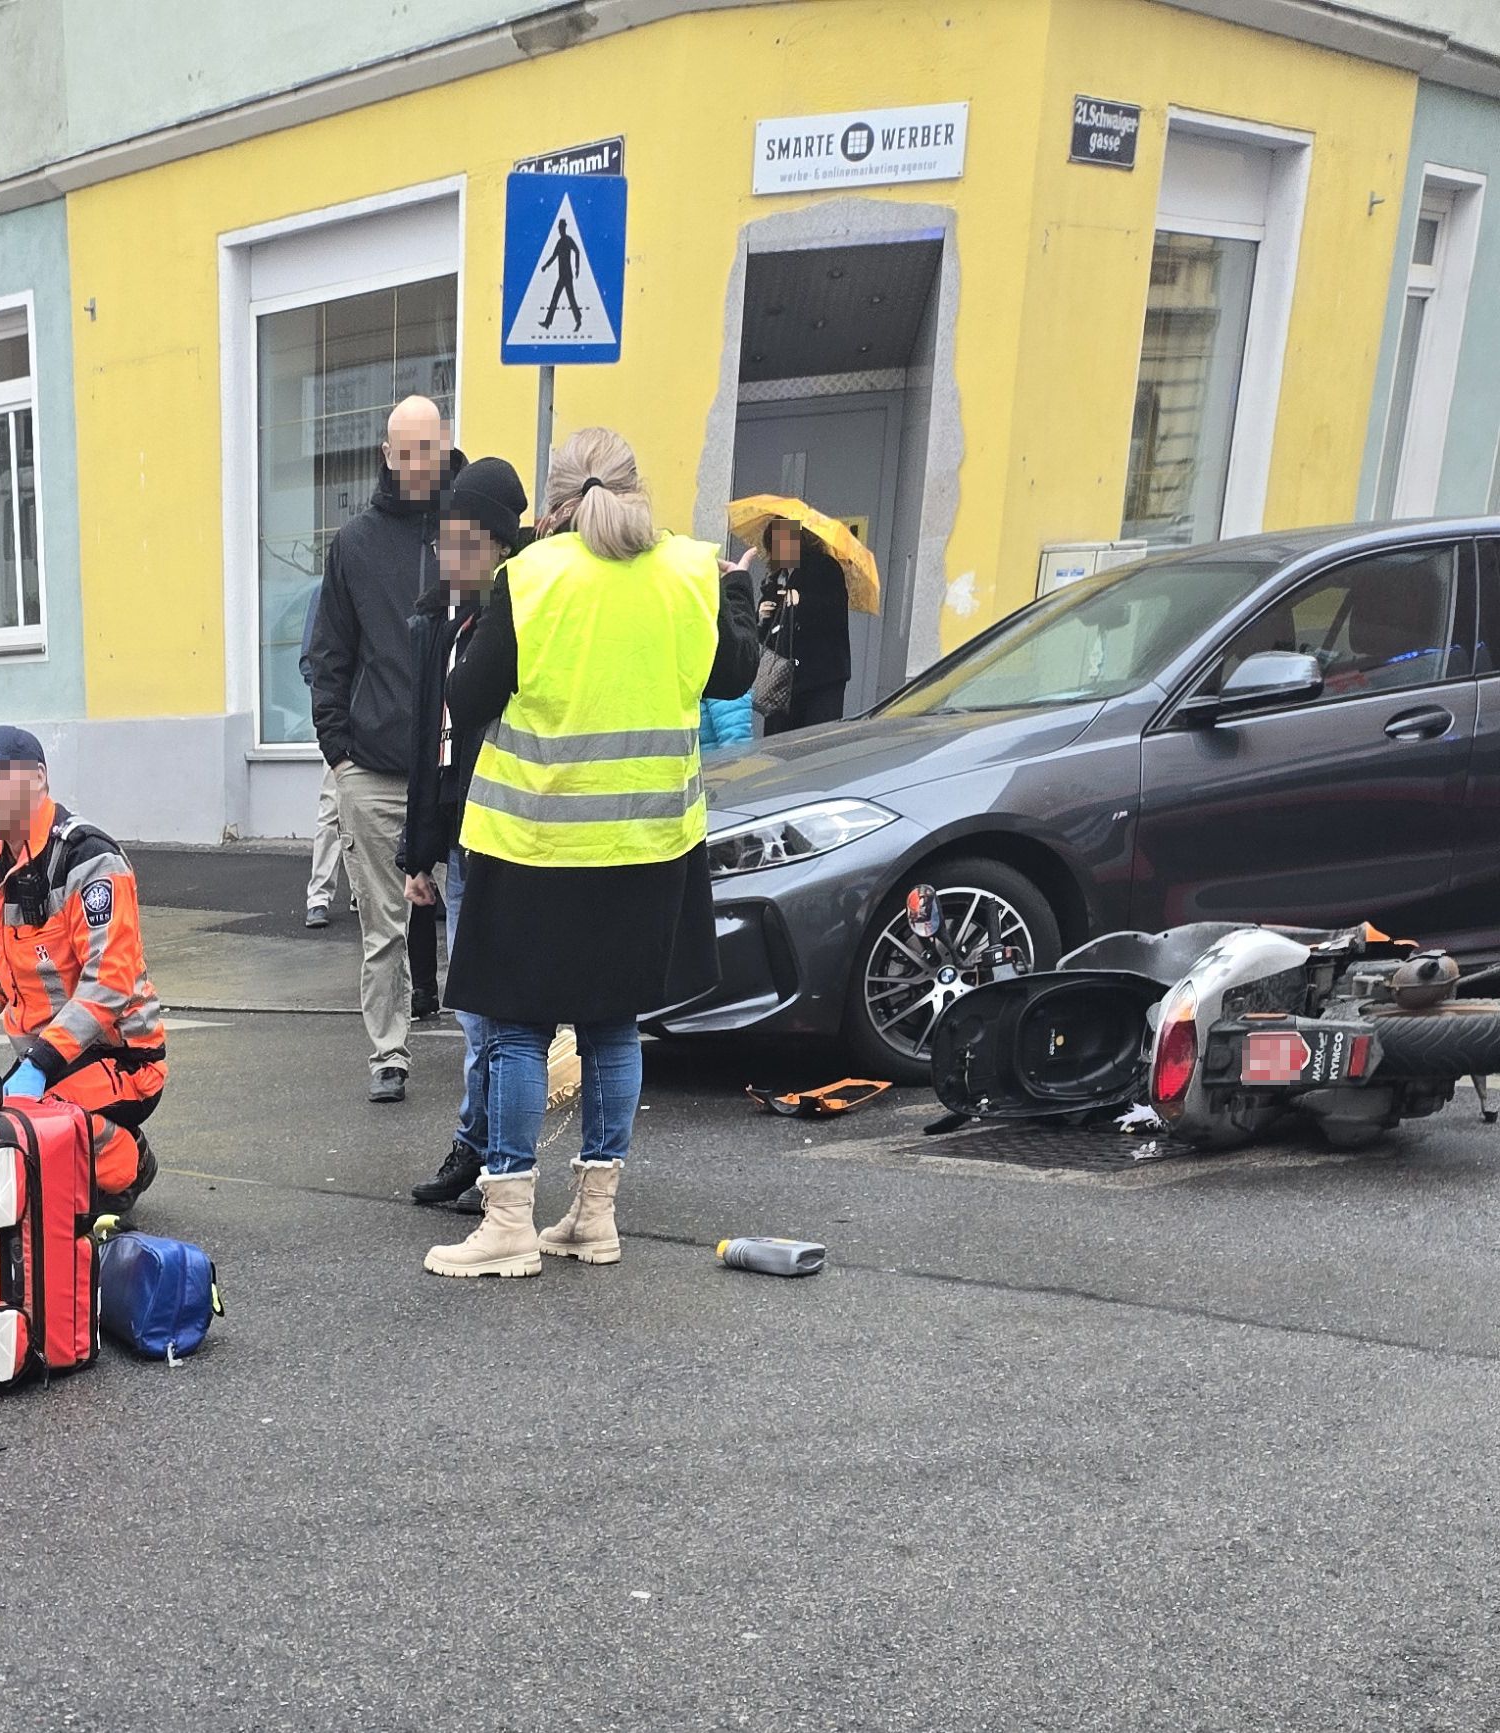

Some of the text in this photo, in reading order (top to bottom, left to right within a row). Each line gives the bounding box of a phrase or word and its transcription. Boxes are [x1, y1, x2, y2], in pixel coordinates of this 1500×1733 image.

[766, 123, 955, 161] SMARTE WERBER
[1089, 132, 1121, 153] gasse
[821, 161, 899, 179] onlinemarketing
[901, 160, 938, 175] agentur
[1312, 1049, 1325, 1082] MAXX
[1329, 1031, 1344, 1080] KYMCO
